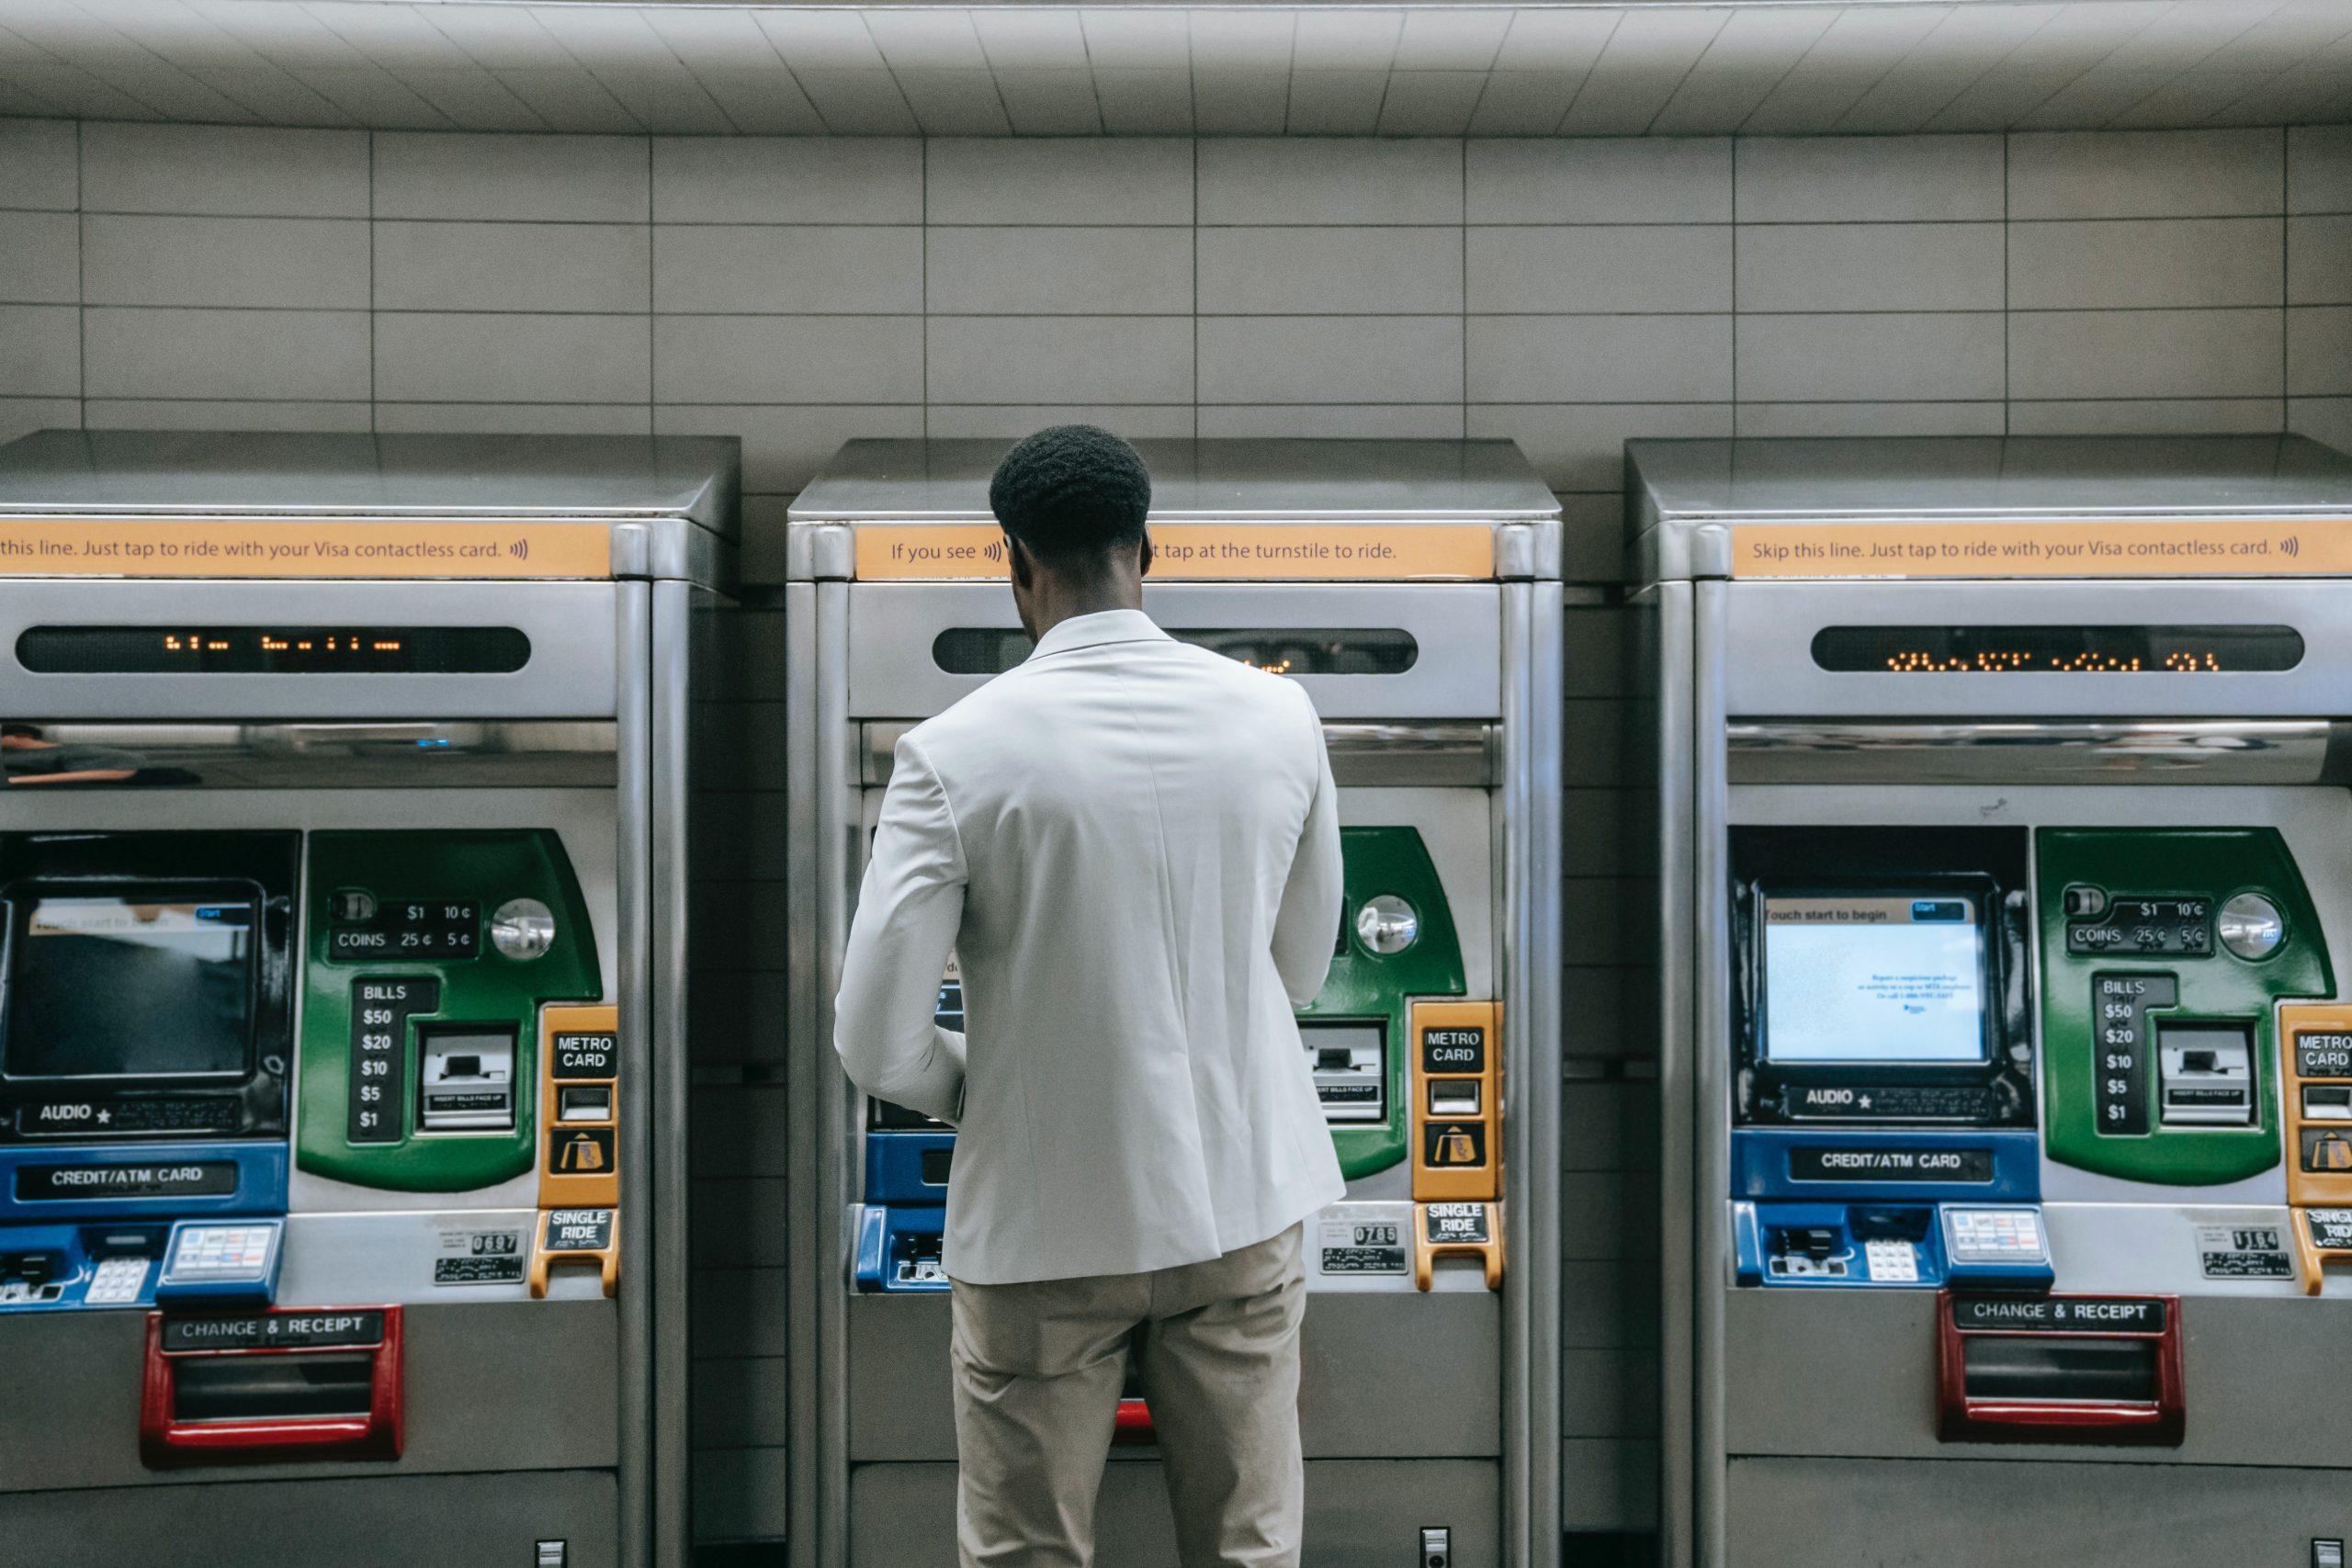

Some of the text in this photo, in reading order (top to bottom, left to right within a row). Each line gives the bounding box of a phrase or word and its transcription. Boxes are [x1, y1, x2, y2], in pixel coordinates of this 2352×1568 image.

[0, 540, 502, 560] this line. Just tap to ride with your Visa contactless card.
[891, 544, 976, 563] If you see
[1165, 544, 1193, 560] tap
[1199, 544, 1216, 558] at
[1222, 543, 1250, 558] the
[1256, 543, 1329, 558] turnstile
[1335, 544, 1352, 558] to
[1358, 543, 1396, 558] ride.
[1753, 539, 2272, 561] Skip this line. Just tap to ride with your Visa contactless card.
[198, 908, 220, 918] Start
[407, 907, 424, 919] $1
[1915, 903, 1937, 912] Start
[2141, 904, 2157, 917] $1
[1805, 909, 1834, 920] start
[1837, 909, 1849, 920] to
[1852, 909, 1886, 922] begin
[338, 933, 386, 947] COINS
[2075, 930, 2120, 942] COINS
[364, 987, 406, 999] BILLS
[2103, 981, 2144, 994] BILLS
[363, 1010, 391, 1024] $50
[2105, 1005, 2132, 1019] $50
[363, 1036, 391, 1050] $20
[1428, 1032, 1479, 1045] METRO
[2106, 1030, 2133, 1043] $20
[2300, 1036, 2352, 1049] METRO
[559, 1038, 611, 1051] METRO
[563, 1054, 605, 1066] CARD
[1433, 1048, 1474, 1061] CARD
[2306, 1053, 2348, 1066] CARD
[2107, 1055, 2132, 1068] $10
[362, 1062, 388, 1076] $10
[361, 1087, 380, 1100] $5
[2108, 1080, 2127, 1094] $5
[1806, 1090, 1853, 1103] AUDIO
[40, 1105, 91, 1120] AUDIO
[360, 1112, 379, 1126] $1
[2109, 1105, 2126, 1120] $1
[1822, 1154, 1961, 1168] CREDIT/ATM CARD
[51, 1168, 203, 1185] CREDIT/ATM CARD
[1429, 1205, 1482, 1217] SINGLE
[552, 1212, 607, 1224] SINGLE
[1441, 1219, 1475, 1232] RIDE
[561, 1226, 597, 1239] RIDE
[1355, 1227, 1396, 1241] 0785
[473, 1235, 516, 1250] 0697
[1974, 1304, 2147, 1319] CHANGE & RECEIPT
[183, 1317, 363, 1337] CHANGE & RECEIPT
